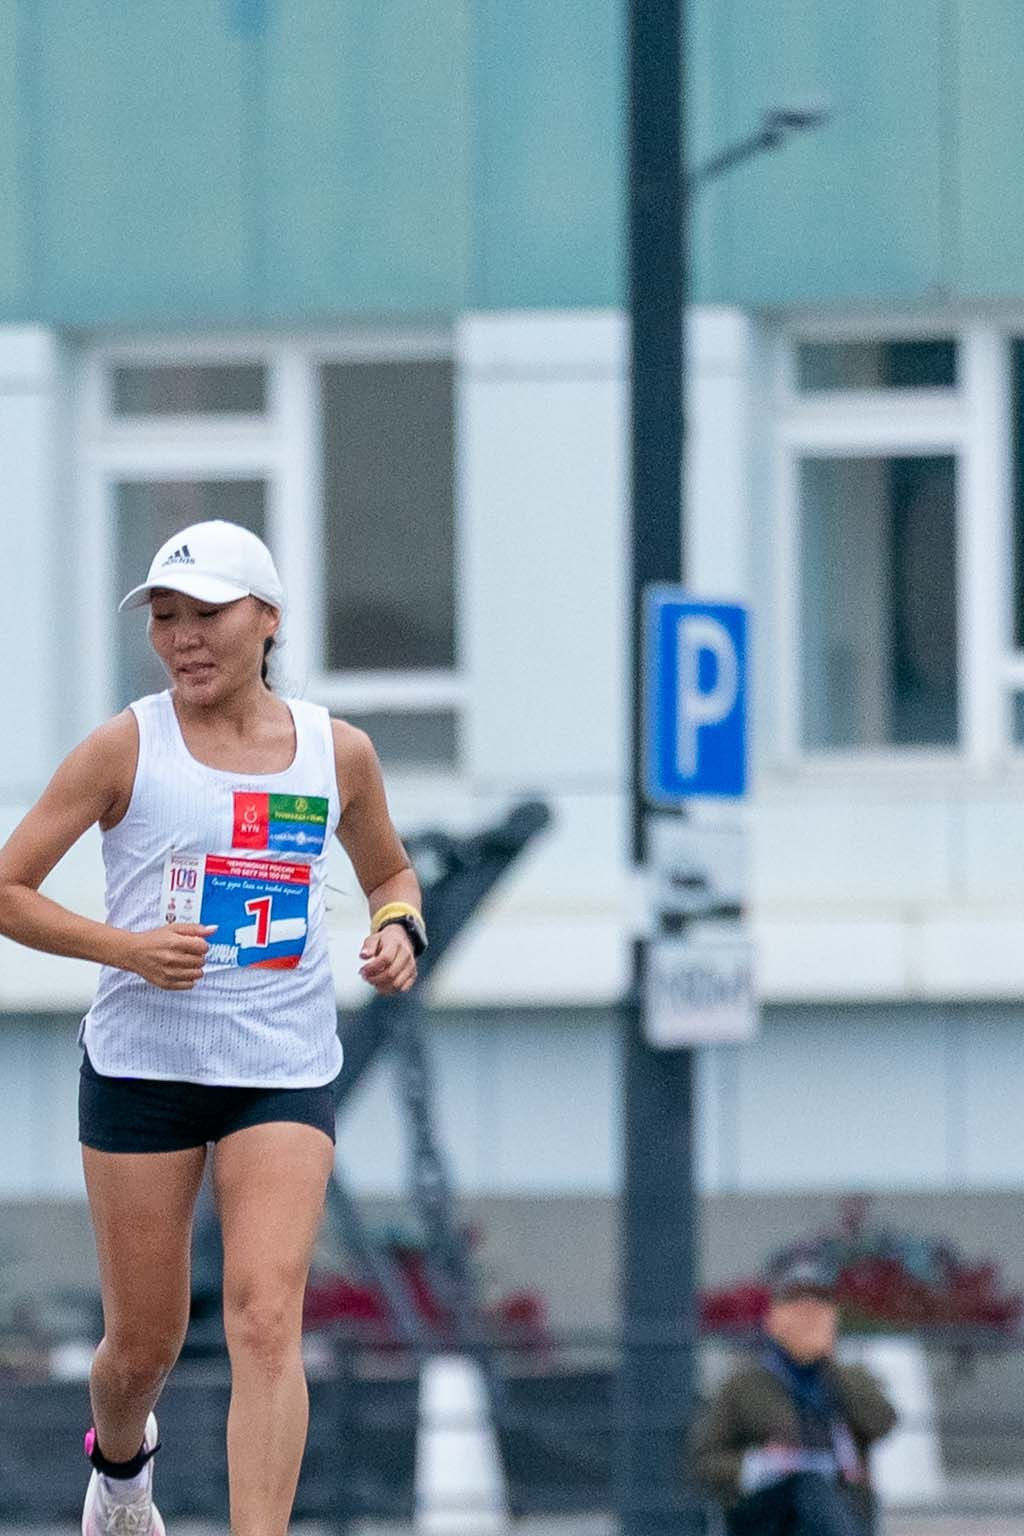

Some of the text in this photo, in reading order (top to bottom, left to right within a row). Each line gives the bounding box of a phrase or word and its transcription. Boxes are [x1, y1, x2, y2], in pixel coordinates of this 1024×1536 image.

[675, 613, 738, 780] P
[170, 868, 197, 891] 100
[245, 896, 272, 948] 1
